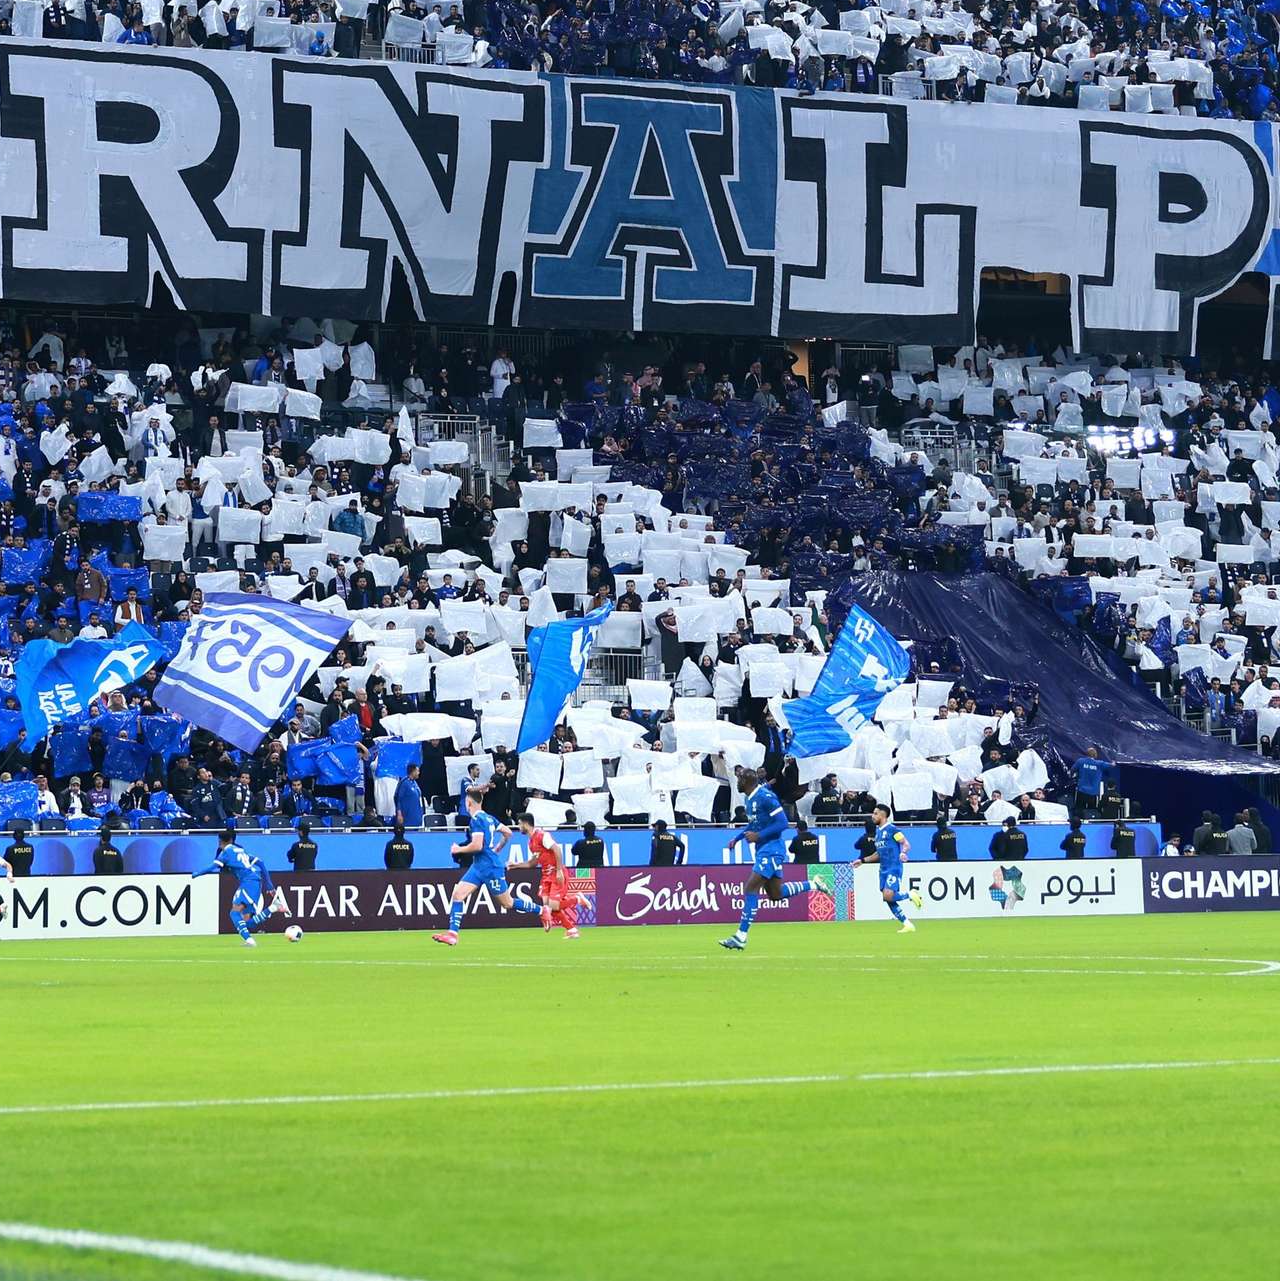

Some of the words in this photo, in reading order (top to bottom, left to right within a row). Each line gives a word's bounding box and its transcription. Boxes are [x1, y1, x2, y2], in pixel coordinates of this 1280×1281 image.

[14, 847, 32, 855] POLICE
[260, 884, 362, 918] ATAR
[615, 872, 721, 921] Saudi
[1040, 867, 1116, 905] نيوم
[1150, 871, 1161, 899] AFC
